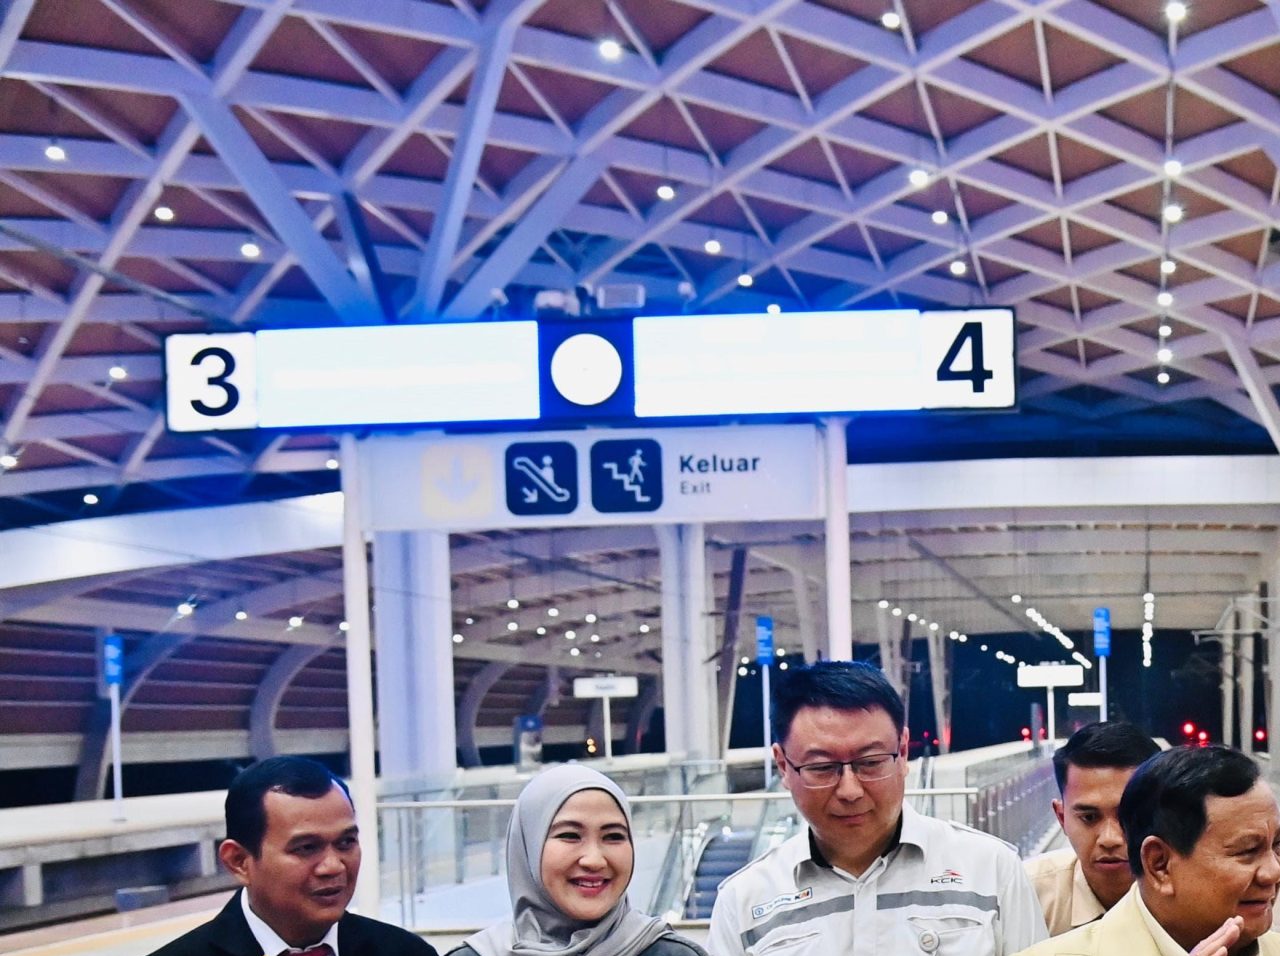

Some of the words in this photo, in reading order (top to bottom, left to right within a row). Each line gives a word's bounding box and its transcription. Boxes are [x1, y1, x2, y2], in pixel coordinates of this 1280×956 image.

[936, 321, 993, 393] 4
[190, 347, 240, 417] 3
[679, 454, 760, 473] Keluar
[680, 481, 711, 495] Exit
